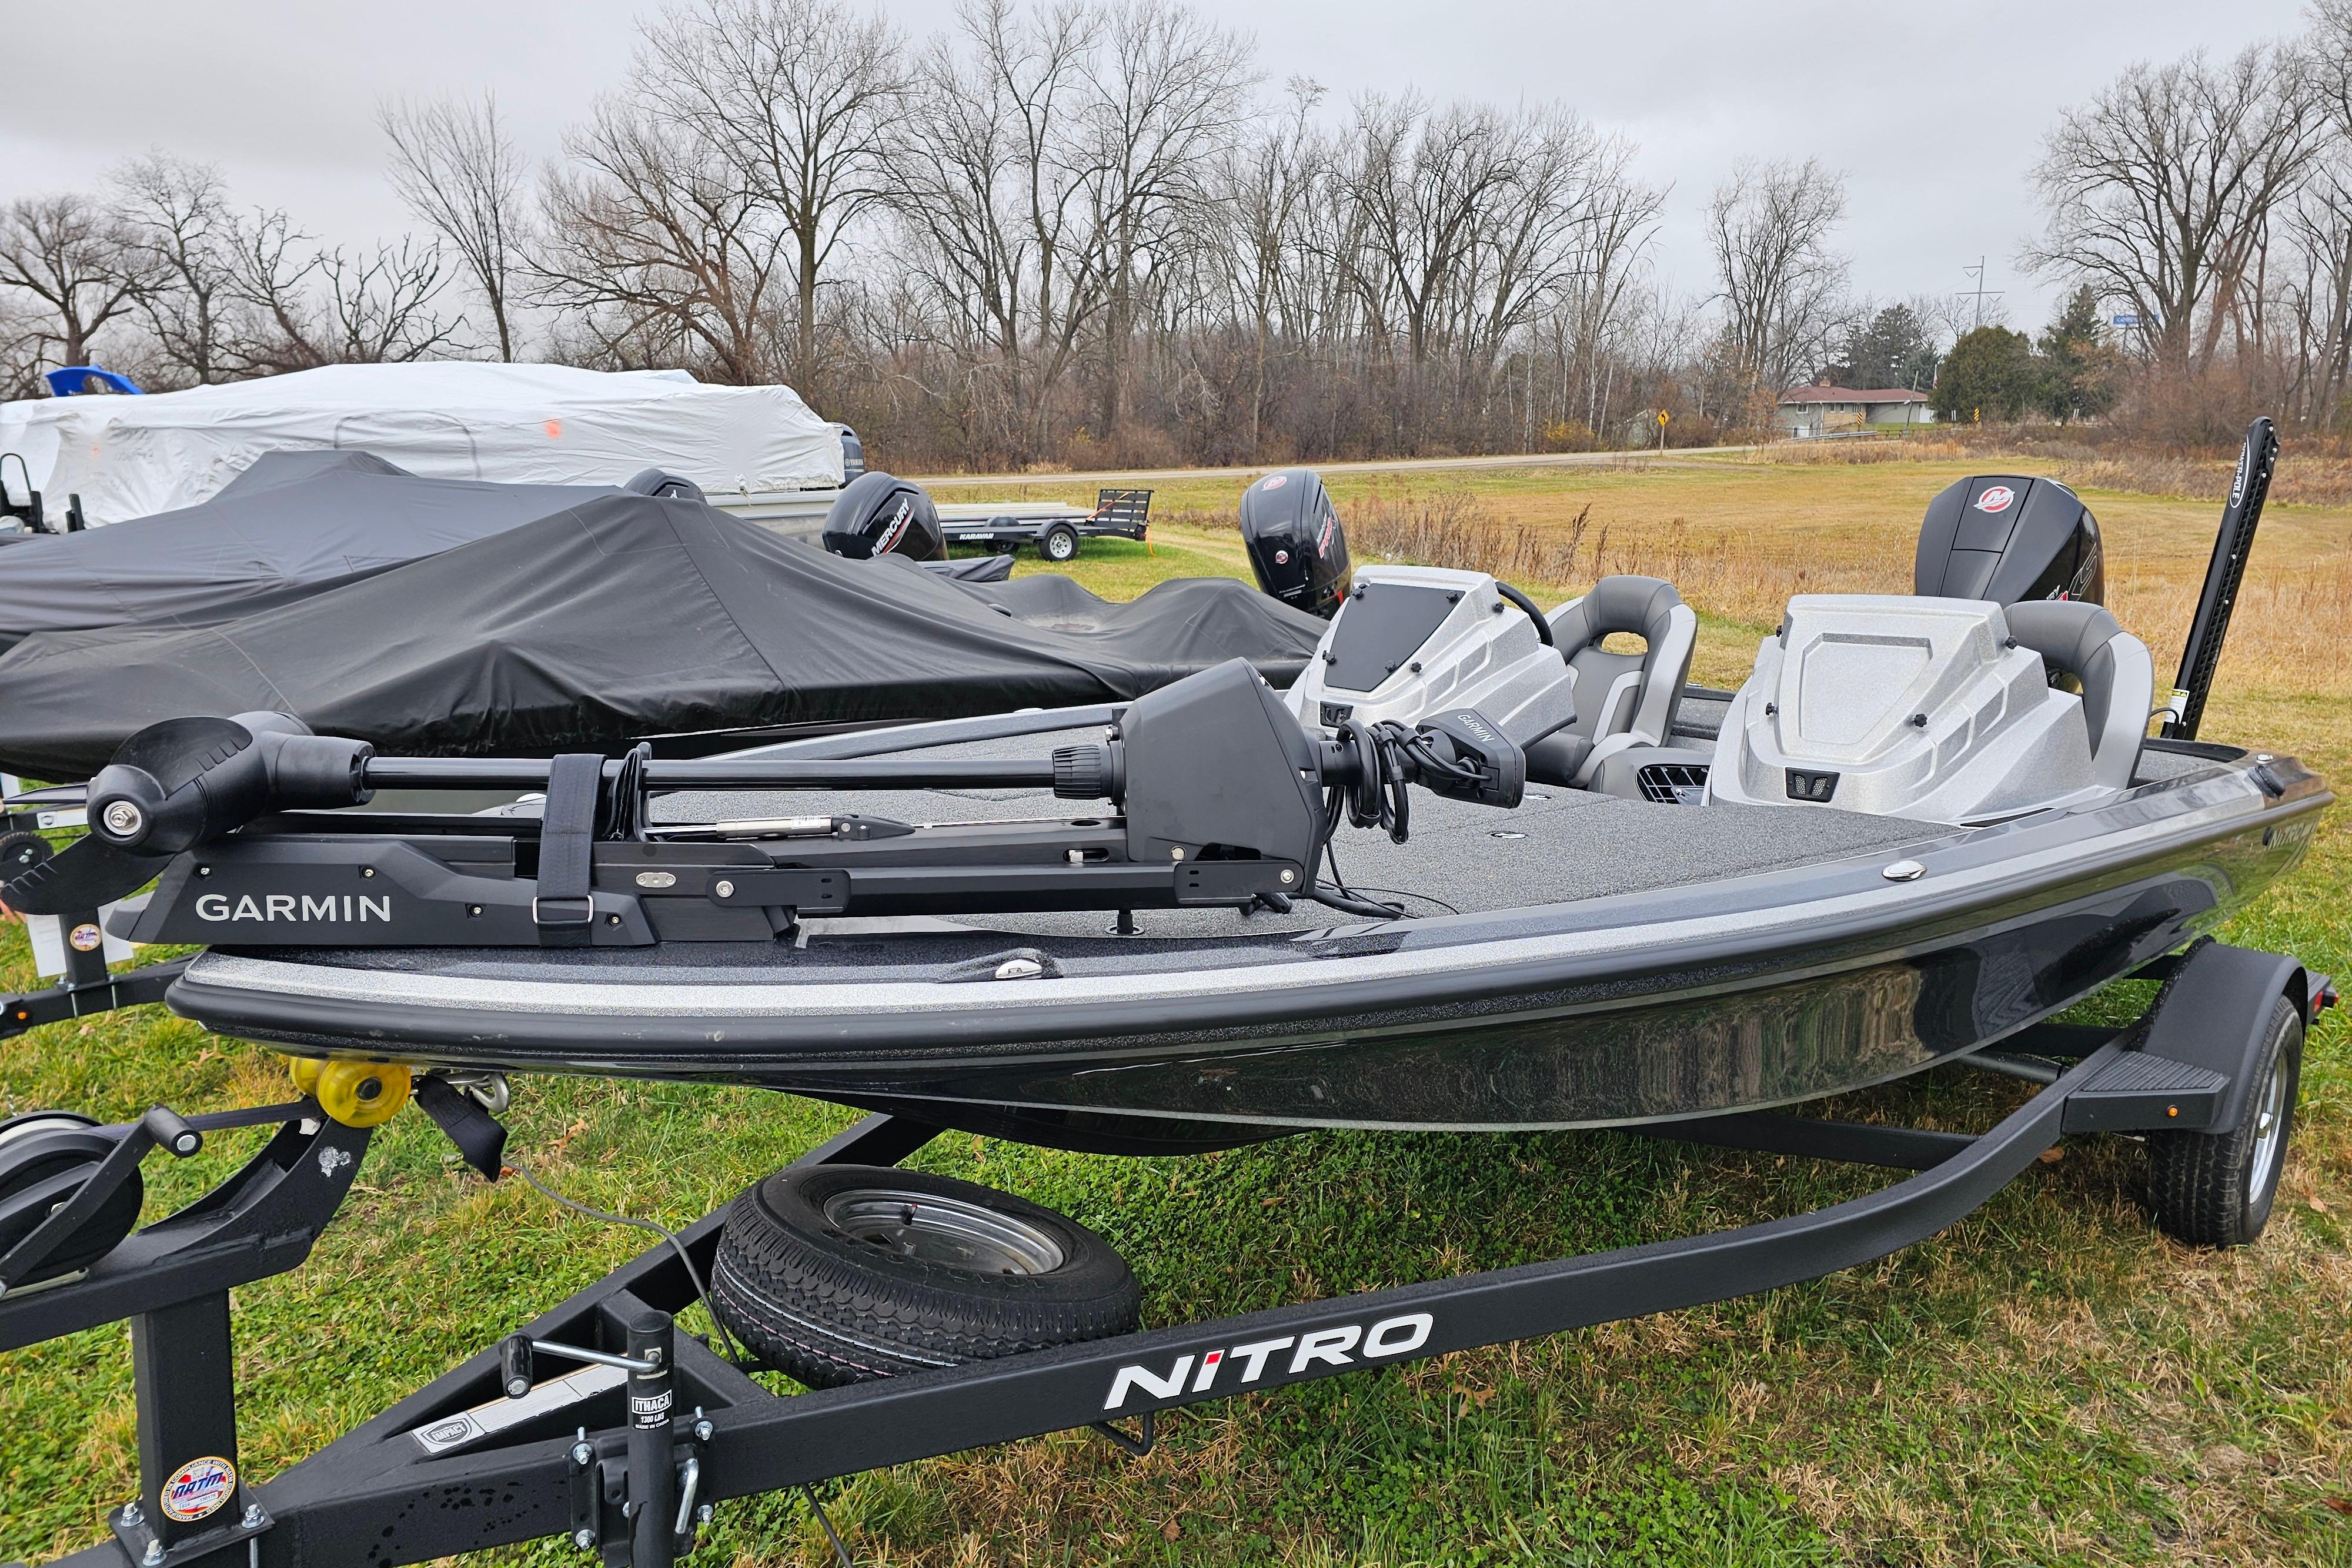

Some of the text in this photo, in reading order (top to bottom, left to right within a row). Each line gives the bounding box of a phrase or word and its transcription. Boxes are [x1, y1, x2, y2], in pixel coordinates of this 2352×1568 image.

[871, 498, 911, 557] MERCURY
[1458, 714, 1495, 742] GARMIN
[195, 894, 390, 922] GARMIN
[1103, 1313, 1434, 1410] NITRO
[635, 1395, 670, 1412] ITHACA
[641, 1412, 664, 1423] 1300 LBS
[431, 1422, 466, 1442] IMPACT
[172, 1460, 212, 1482] COMPLIANCE
[212, 1460, 228, 1470] WITH
